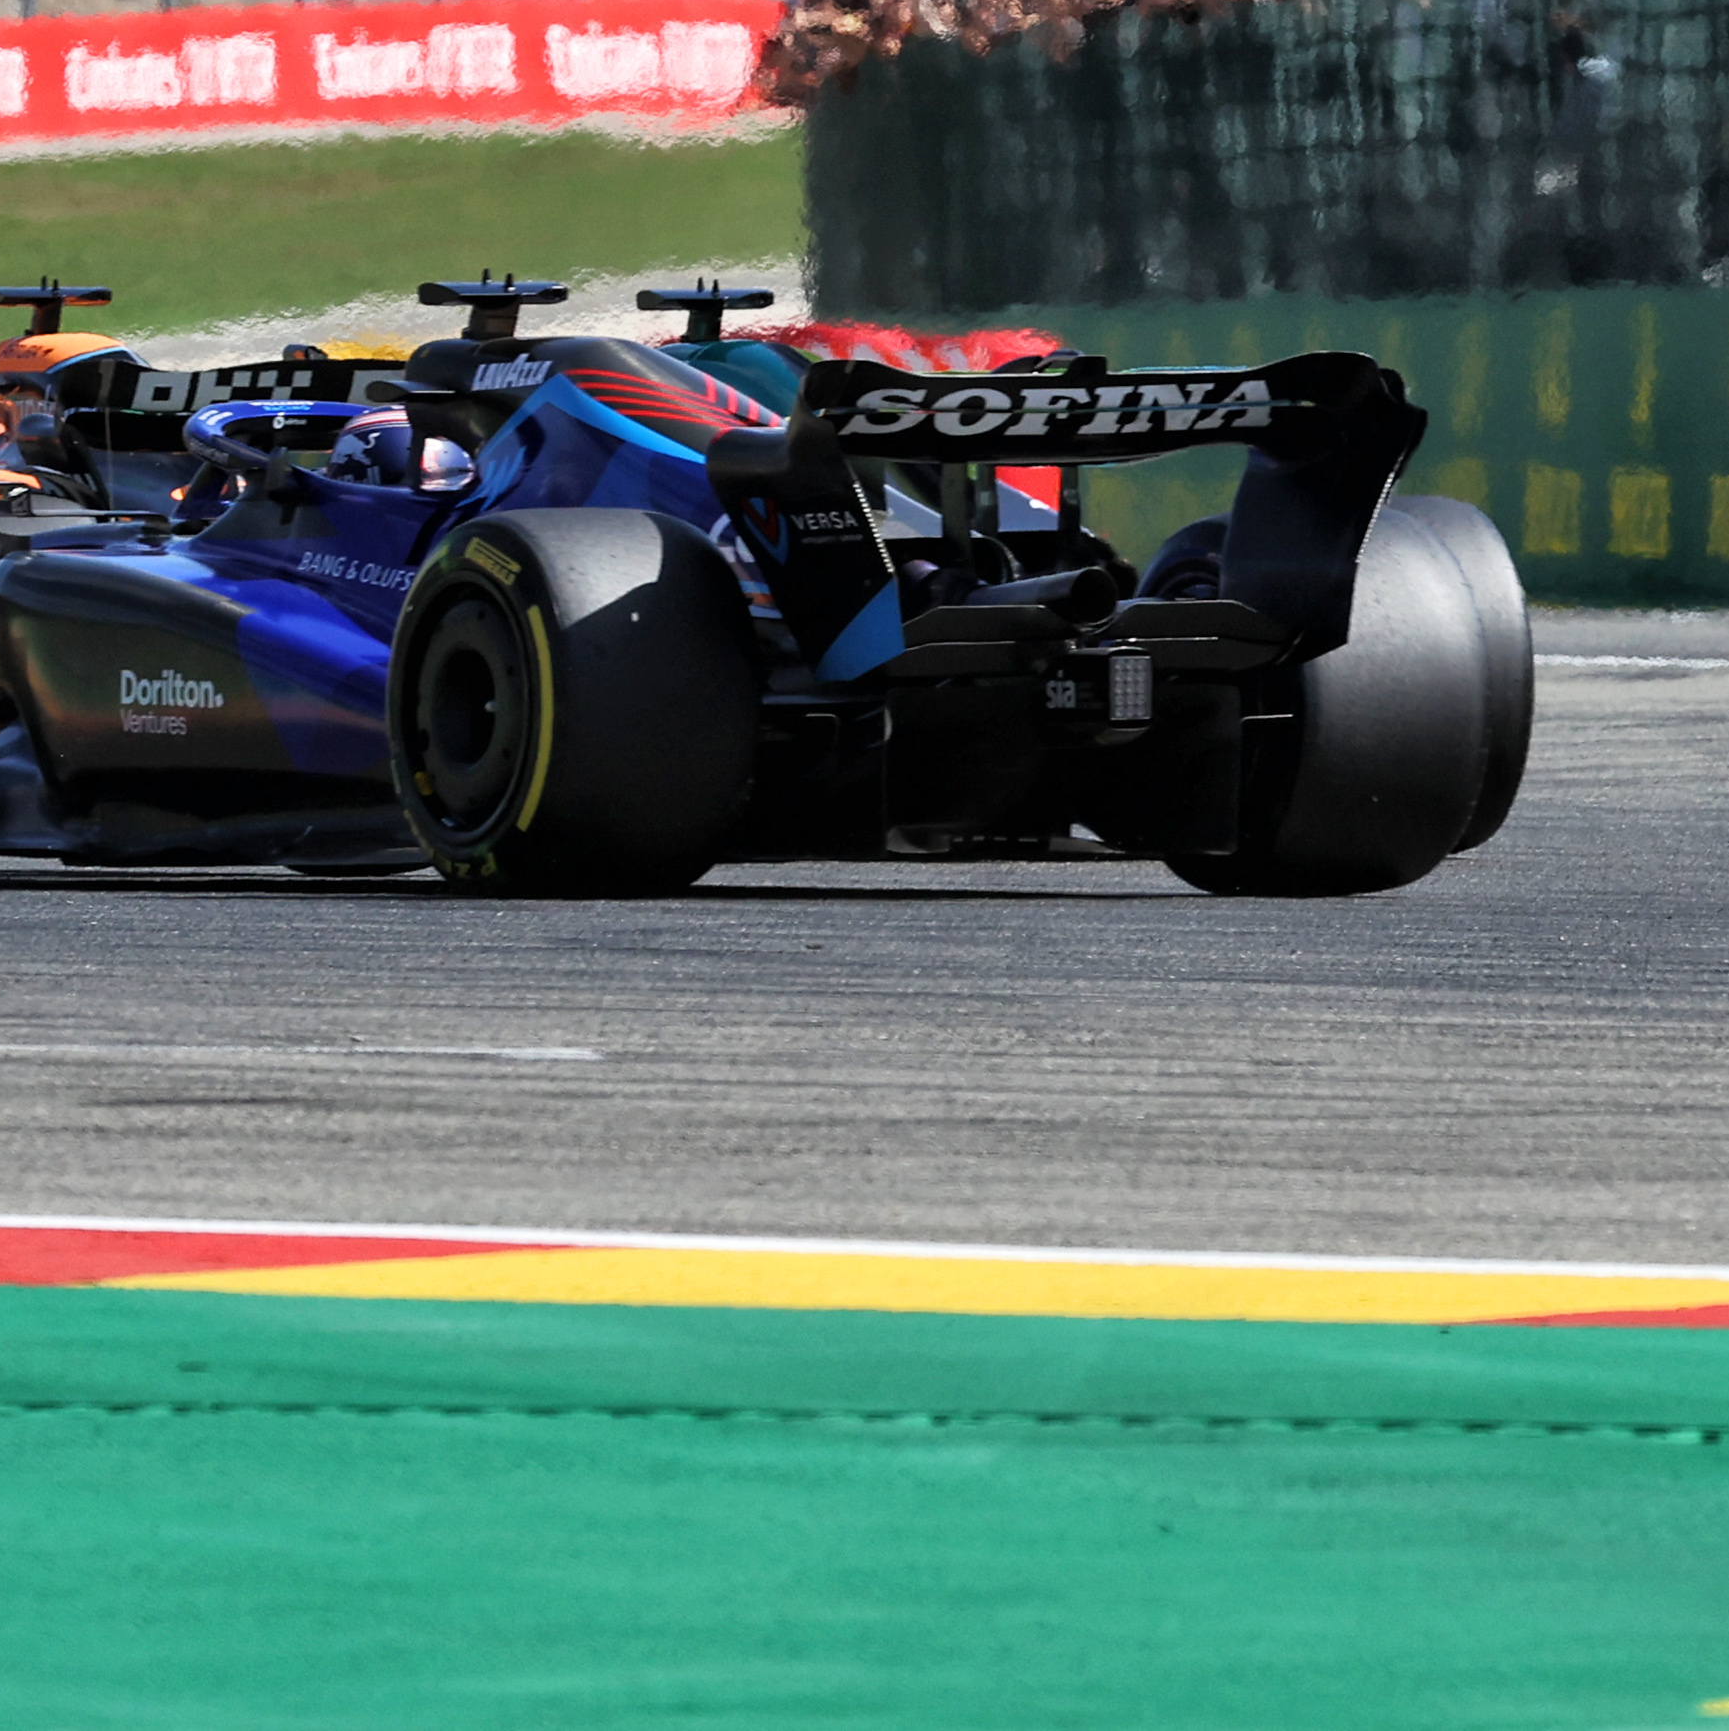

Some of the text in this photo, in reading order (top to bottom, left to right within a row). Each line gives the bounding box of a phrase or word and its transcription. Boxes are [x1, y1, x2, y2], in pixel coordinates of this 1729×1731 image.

[839, 380, 1272, 436] SOFINA
[790, 511, 859, 529] VERSA
[297, 551, 347, 578] BANG
[345, 560, 359, 580] &
[120, 710, 187, 735] Ventures
